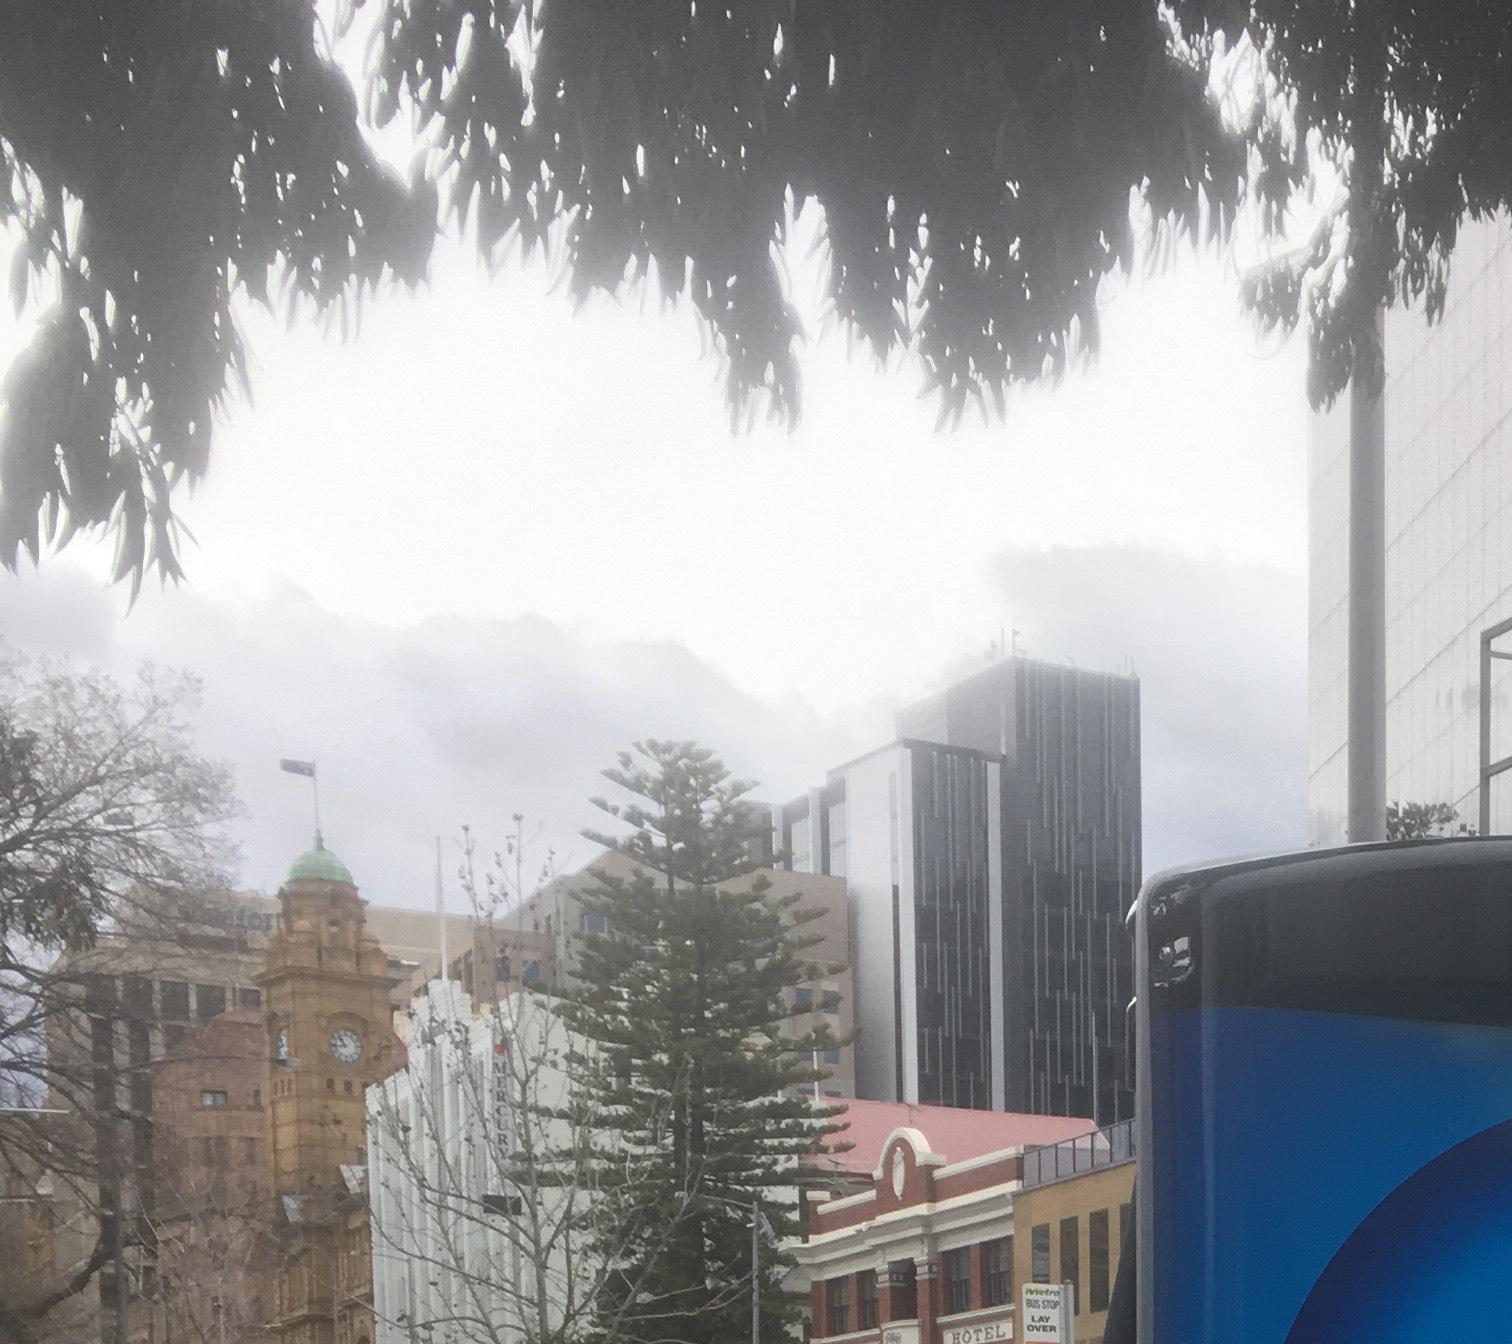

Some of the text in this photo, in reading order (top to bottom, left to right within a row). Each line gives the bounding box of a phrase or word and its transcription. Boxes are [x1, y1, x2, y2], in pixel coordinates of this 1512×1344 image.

[1041, 1299, 1060, 1310] STOP
[1031, 1315, 1051, 1324] LAY
[1026, 1324, 1057, 1333] OVER
